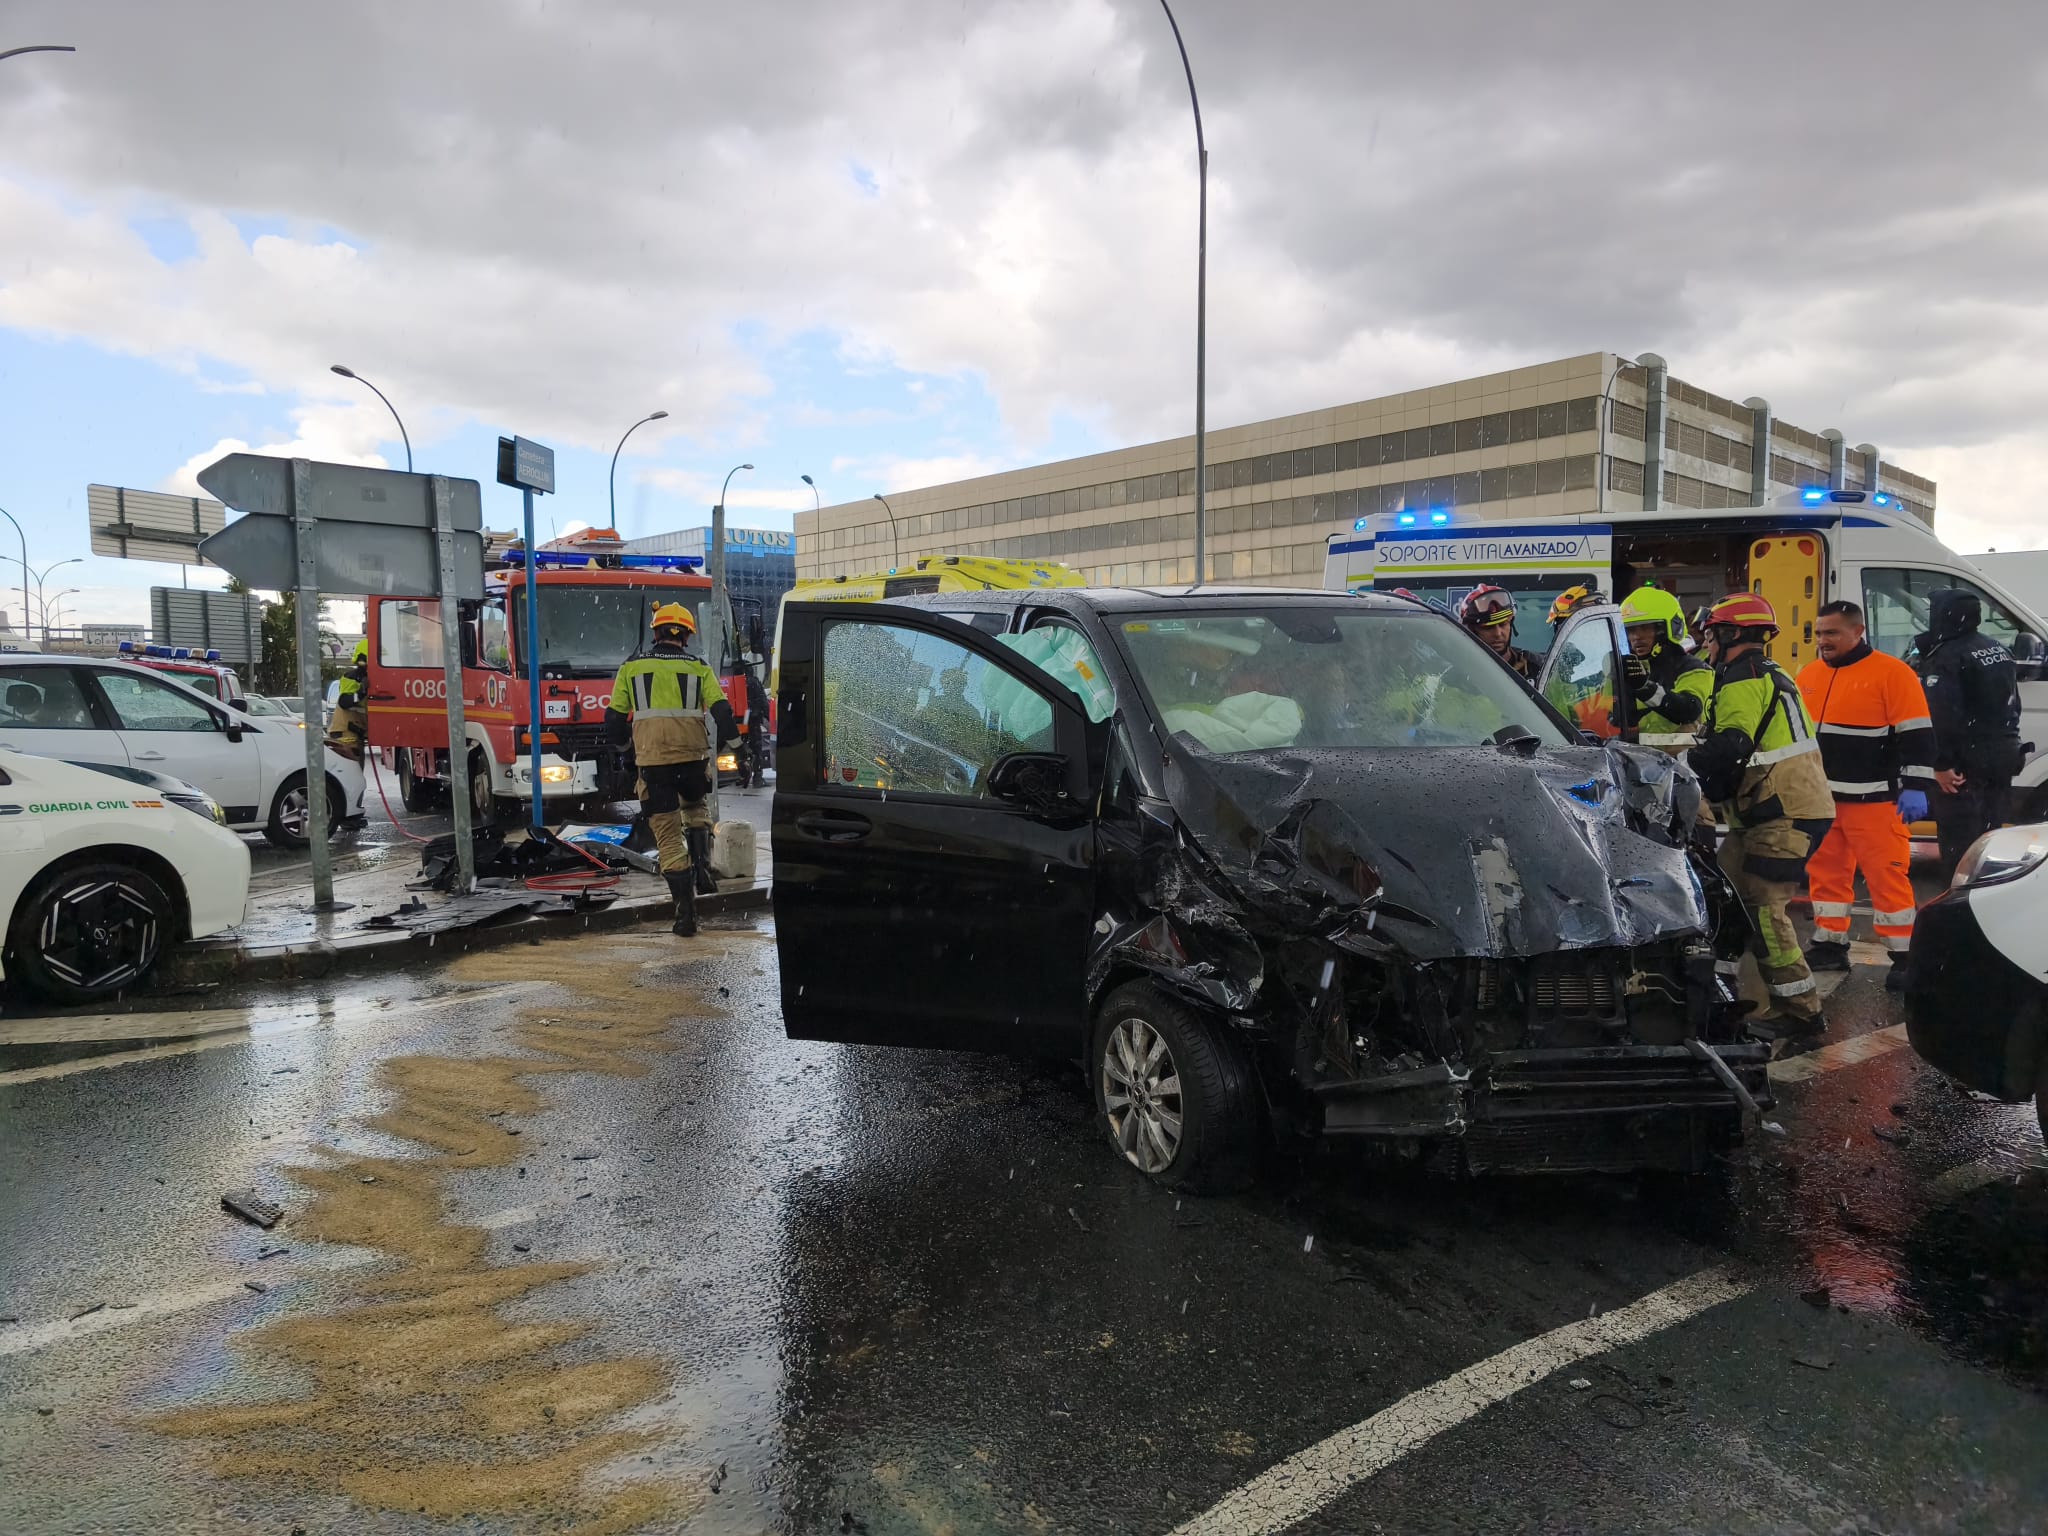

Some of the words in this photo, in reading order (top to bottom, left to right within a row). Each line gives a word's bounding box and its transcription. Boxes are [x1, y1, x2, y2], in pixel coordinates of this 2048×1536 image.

[1379, 545, 1457, 562] SOPORTE
[1463, 543, 1504, 560] VITAL
[1503, 541, 1577, 556] AVANZADO
[1980, 653, 2010, 666] LOCAL
[548, 705, 567, 714] R-4
[29, 802, 93, 814] GUARDIA
[96, 800, 129, 810] CIVIL
